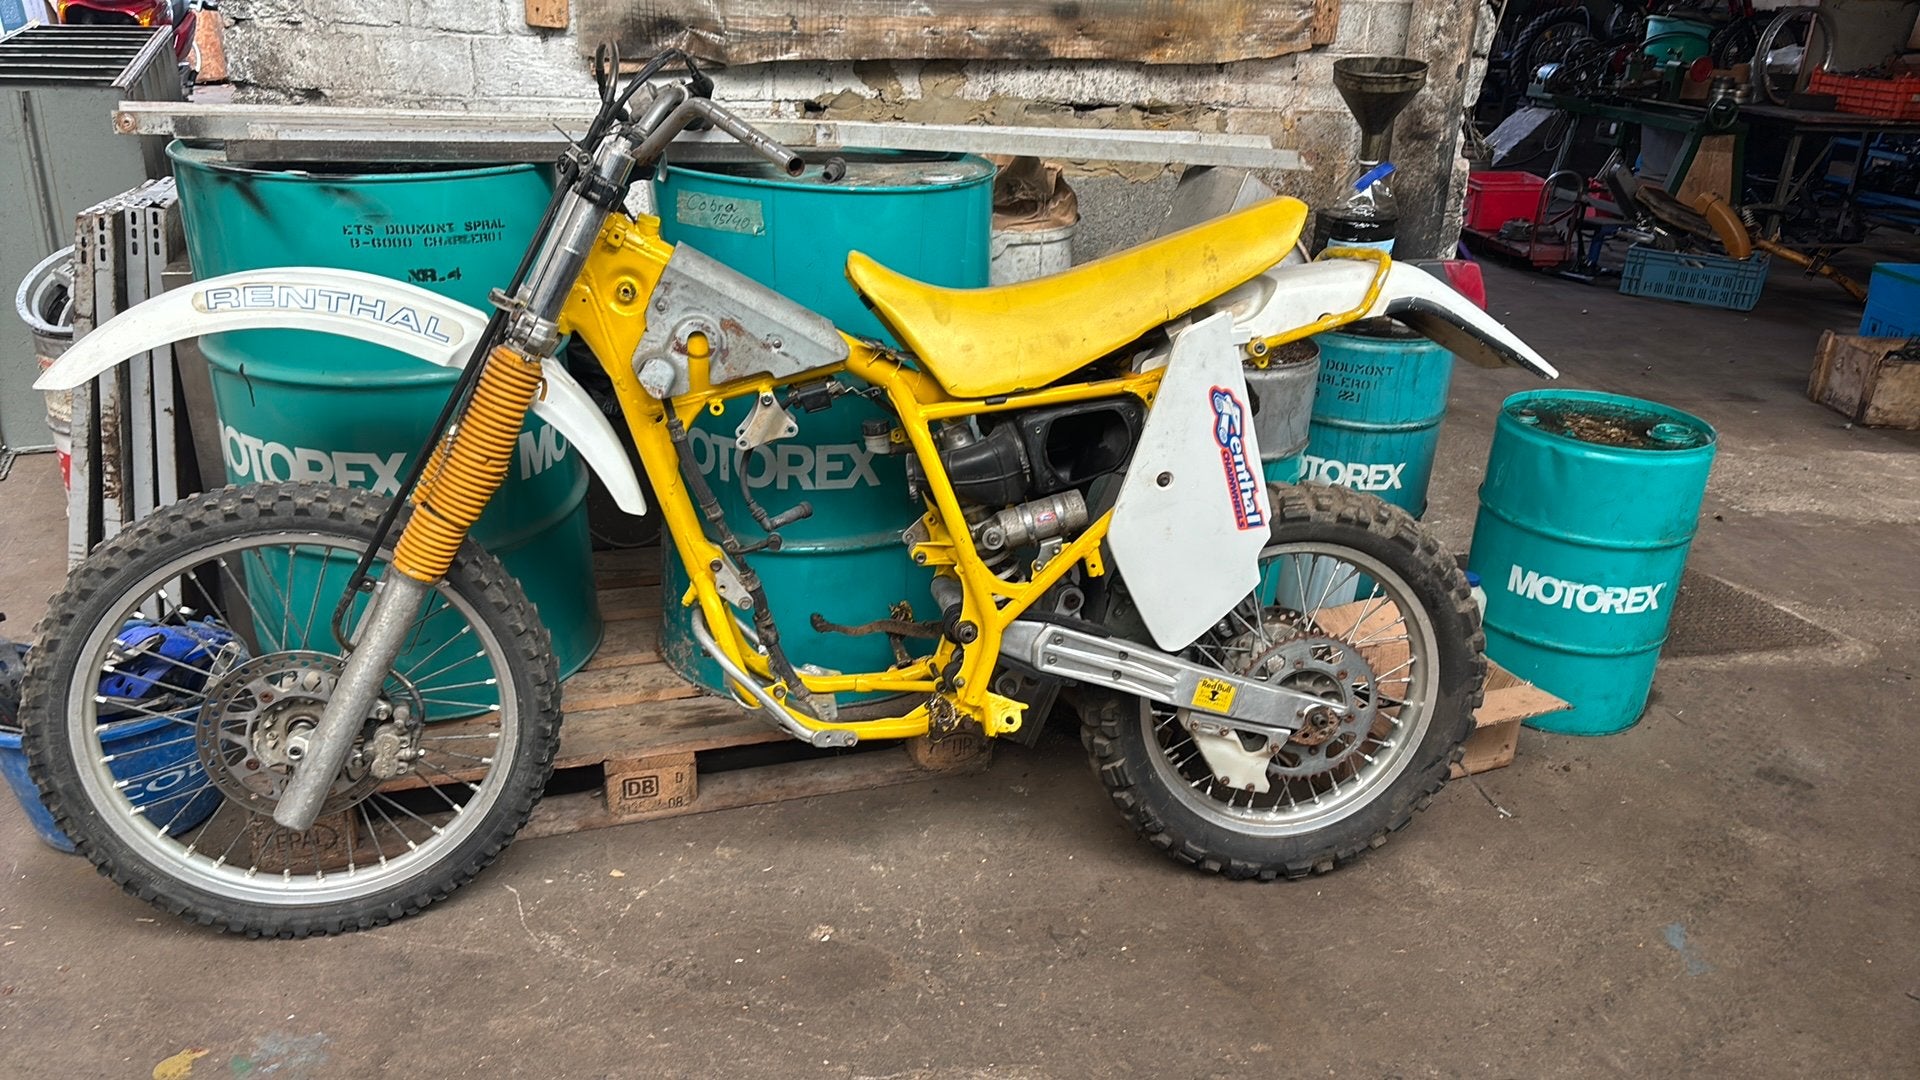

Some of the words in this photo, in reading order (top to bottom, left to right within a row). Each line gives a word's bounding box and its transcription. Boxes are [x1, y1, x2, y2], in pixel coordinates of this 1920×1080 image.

[686, 193, 738, 213] Cobra
[343, 224, 374, 235] ETS
[385, 222, 454, 235] DOUMONT
[205, 285, 450, 343] RENTHAL
[1325, 359, 1395, 376] DOUMONT
[218, 419, 407, 497] OTOREX
[687, 427, 881, 490] OTOREX
[1223, 451, 1246, 529] CHAINWHEELS
[1507, 564, 1667, 614] MOTOREX
[1202, 679, 1218, 690] Red
[1217, 683, 1233, 693] Bull
[628, 780, 655, 797] DB
